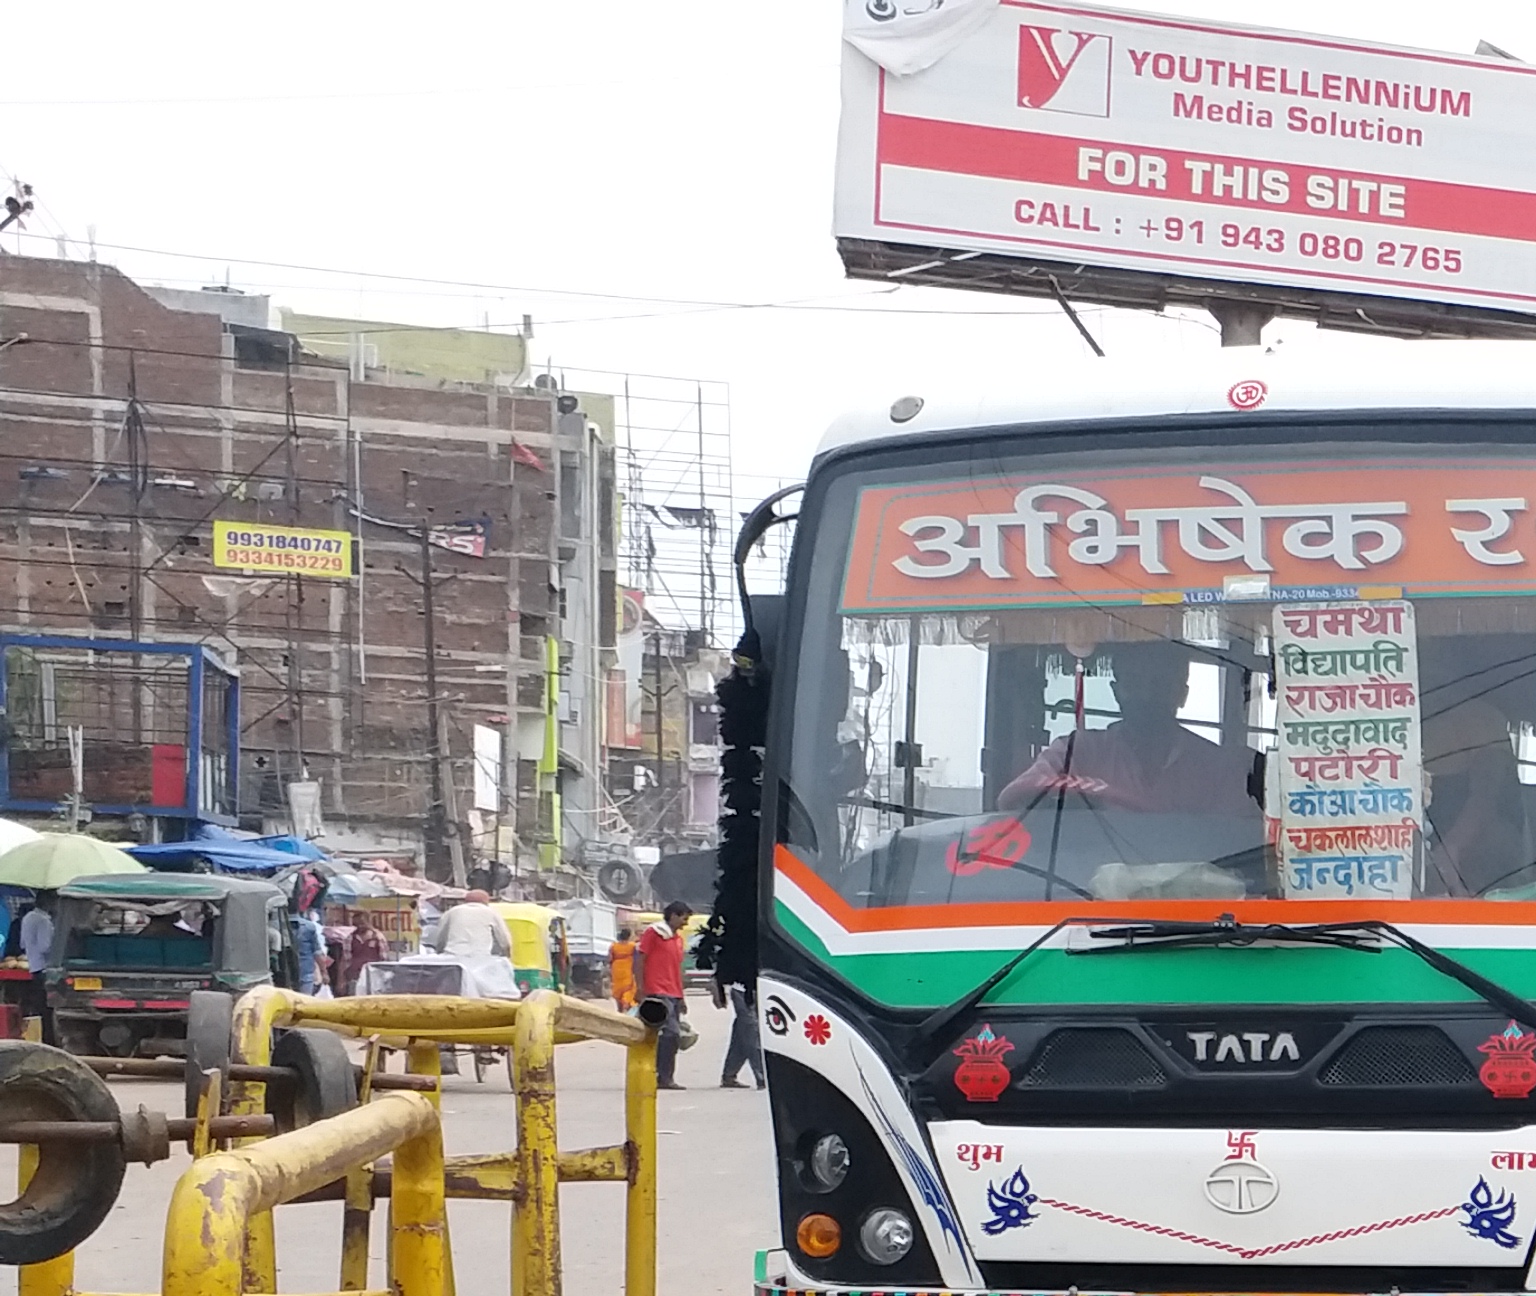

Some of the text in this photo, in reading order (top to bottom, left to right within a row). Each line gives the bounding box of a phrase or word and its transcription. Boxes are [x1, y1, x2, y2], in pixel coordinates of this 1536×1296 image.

[1173, 92, 1423, 147] Media Solution
[1077, 146, 1406, 218] FOR THIS SITE
[1015, 199, 1101, 232] CALL
[1139, 217, 1204, 244] +91
[1221, 223, 1286, 253] 943
[1299, 232, 1363, 262] 080
[1376, 241, 1463, 273] 2765
[226, 530, 343, 554] 9931840747
[892, 475, 1410, 579] अभिषेक
[226, 549, 343, 571] 9334153229
[1280, 606, 1406, 640] चमथा
[1278, 640, 1409, 678] विद्यापति
[1285, 674, 1416, 718] राजा चौक
[1288, 747, 1403, 783] पटोरी
[1287, 855, 1405, 895] जन्दाहा
[1187, 1031, 1300, 1063] TATA
[956, 1143, 1005, 1171] शुभ
